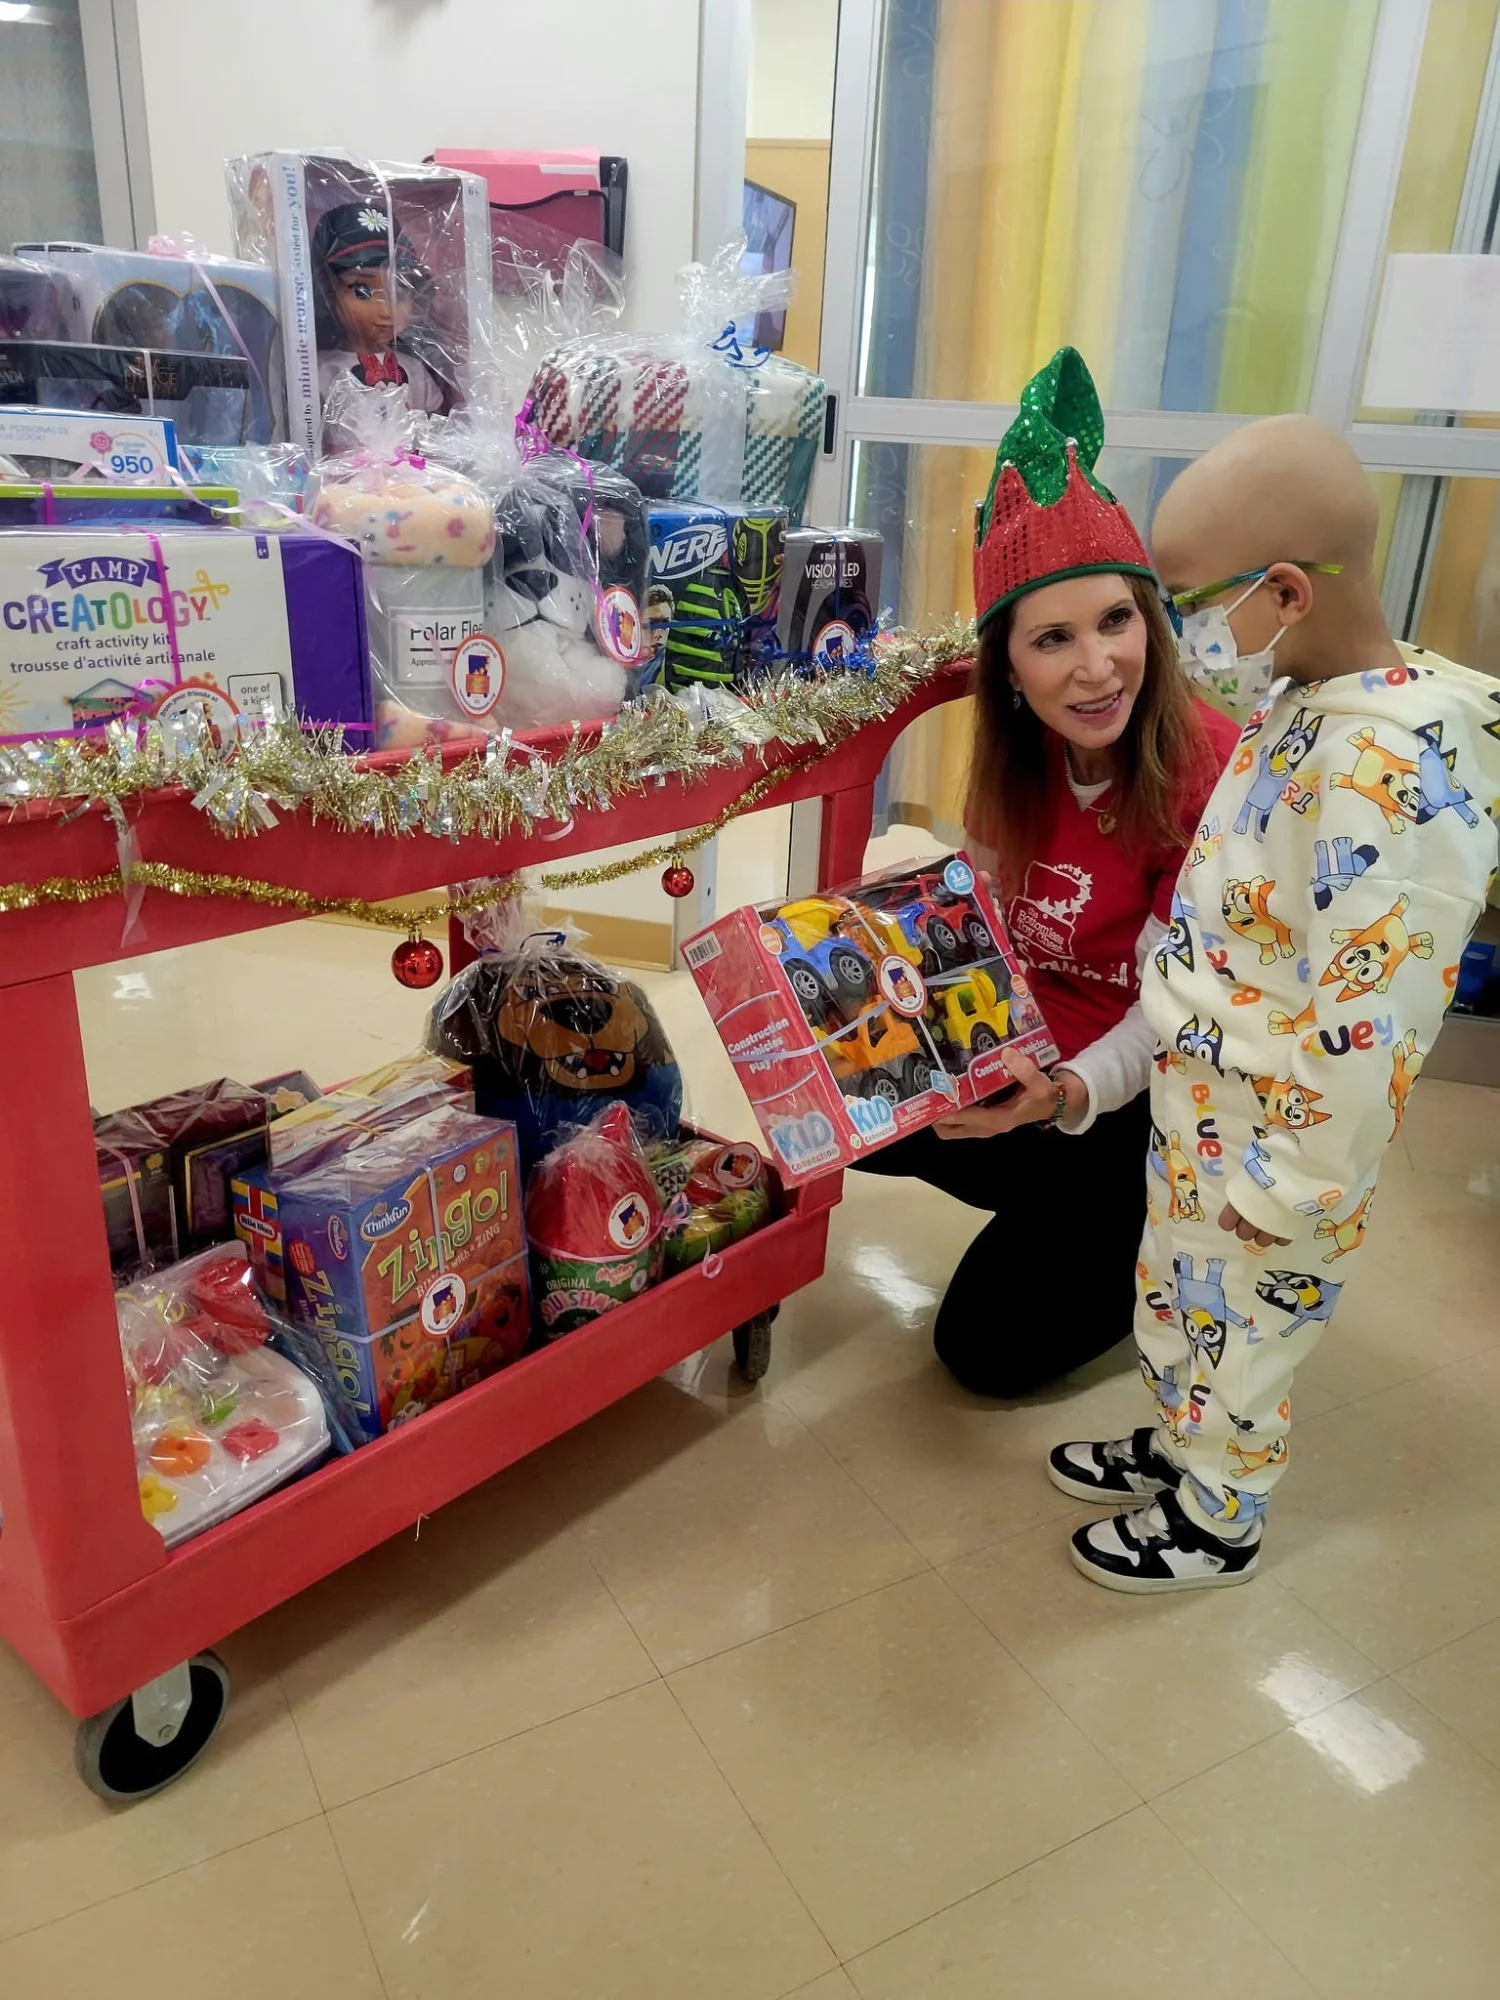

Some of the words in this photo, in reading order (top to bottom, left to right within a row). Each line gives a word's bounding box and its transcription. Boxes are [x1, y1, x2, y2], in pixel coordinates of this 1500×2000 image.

[282, 165, 302, 209] you!
[290, 213, 300, 231] for
[297, 339, 312, 398] minnie
[304, 404, 314, 416] by
[111, 455, 153, 474] 950
[644, 528, 727, 578] NERF
[71, 560, 139, 583] CAMP
[842, 562, 860, 577] LED
[811, 578, 853, 590] HEADPHNES
[56, 637, 91, 651] craft
[96, 635, 149, 650] activity
[153, 633, 173, 646] kit
[10, 661, 69, 673] trousse
[74, 653, 141, 670] d'activité
[146, 649, 216, 665] artisanale
[241, 685, 259, 695] one
[261, 683, 270, 693] of
[242, 698, 249, 706] a
[949, 866, 969, 884] 12
[1017, 921, 1035, 937] Toy
[1036, 932, 1066, 955] Chest
[1018, 909, 1065, 945] Bottomless
[728, 1018, 789, 1054] Construction
[974, 1059, 1003, 1079] Constru
[849, 1097, 892, 1133] KID
[772, 1114, 832, 1161] KID
[791, 1146, 838, 1172] Connection
[377, 1170, 508, 1305] Zingo!
[451, 1250, 471, 1269] with
[475, 1223, 500, 1247] ZING
[546, 1278, 590, 1290] ORIGINAL
